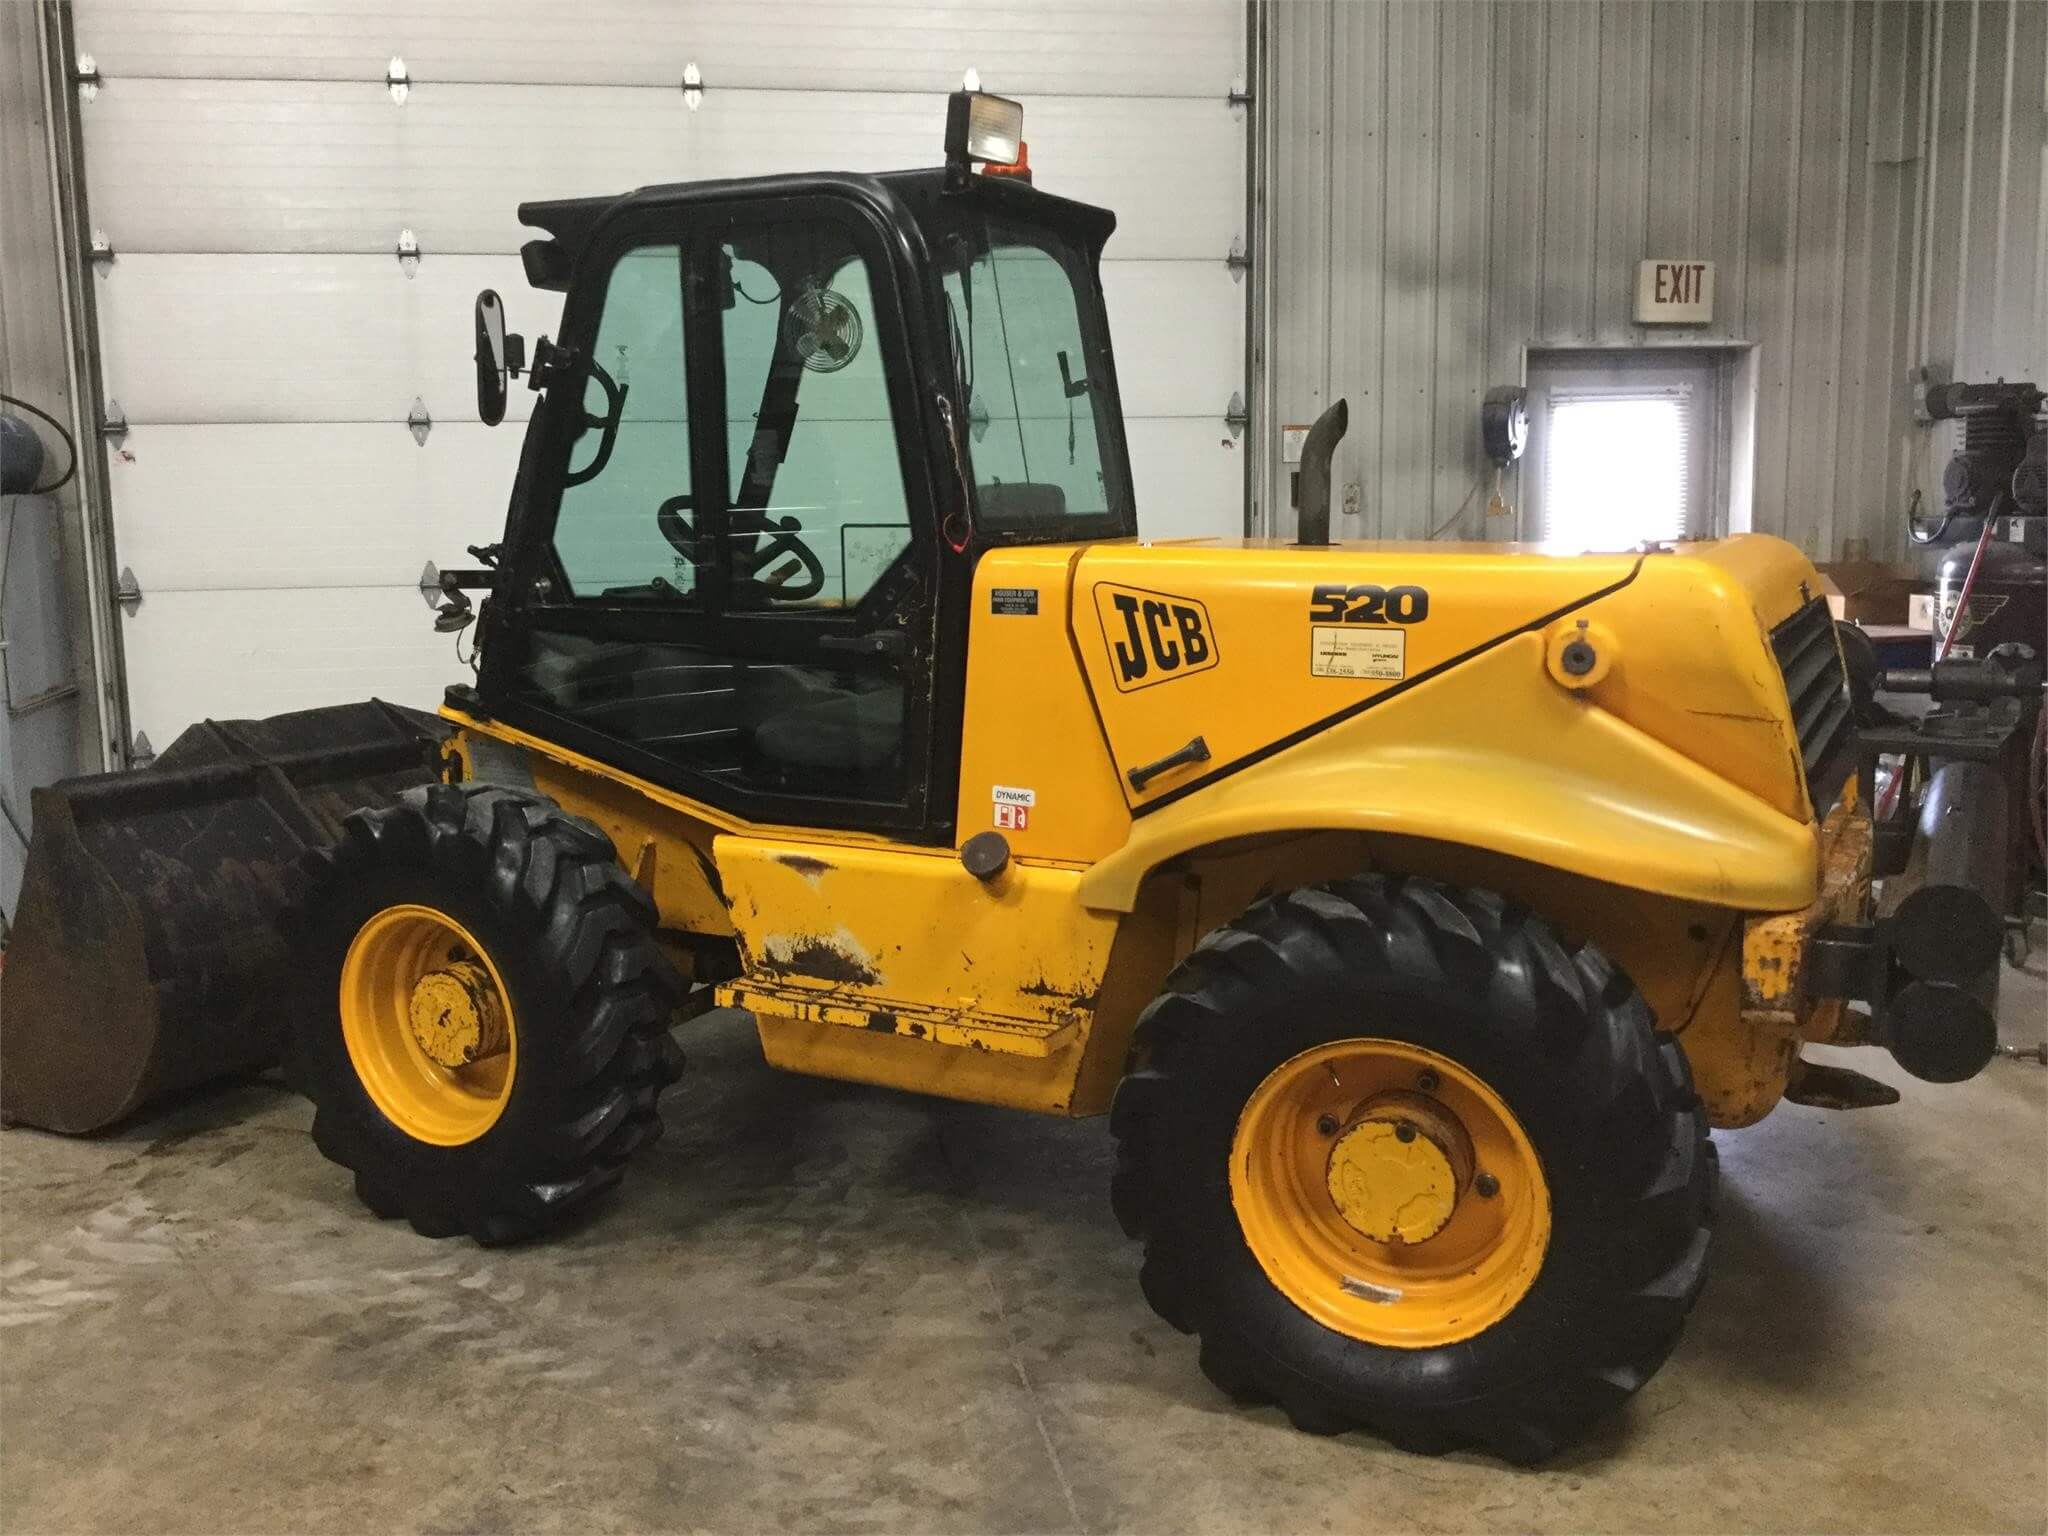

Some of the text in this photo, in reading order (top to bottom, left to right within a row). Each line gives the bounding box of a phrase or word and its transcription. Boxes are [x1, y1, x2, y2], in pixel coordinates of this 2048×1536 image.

[1655, 264, 1706, 304] EXIT
[1310, 585, 1428, 624] 520
[1112, 593, 1209, 682] JCB
[996, 790, 1030, 802] DYNAMIC
